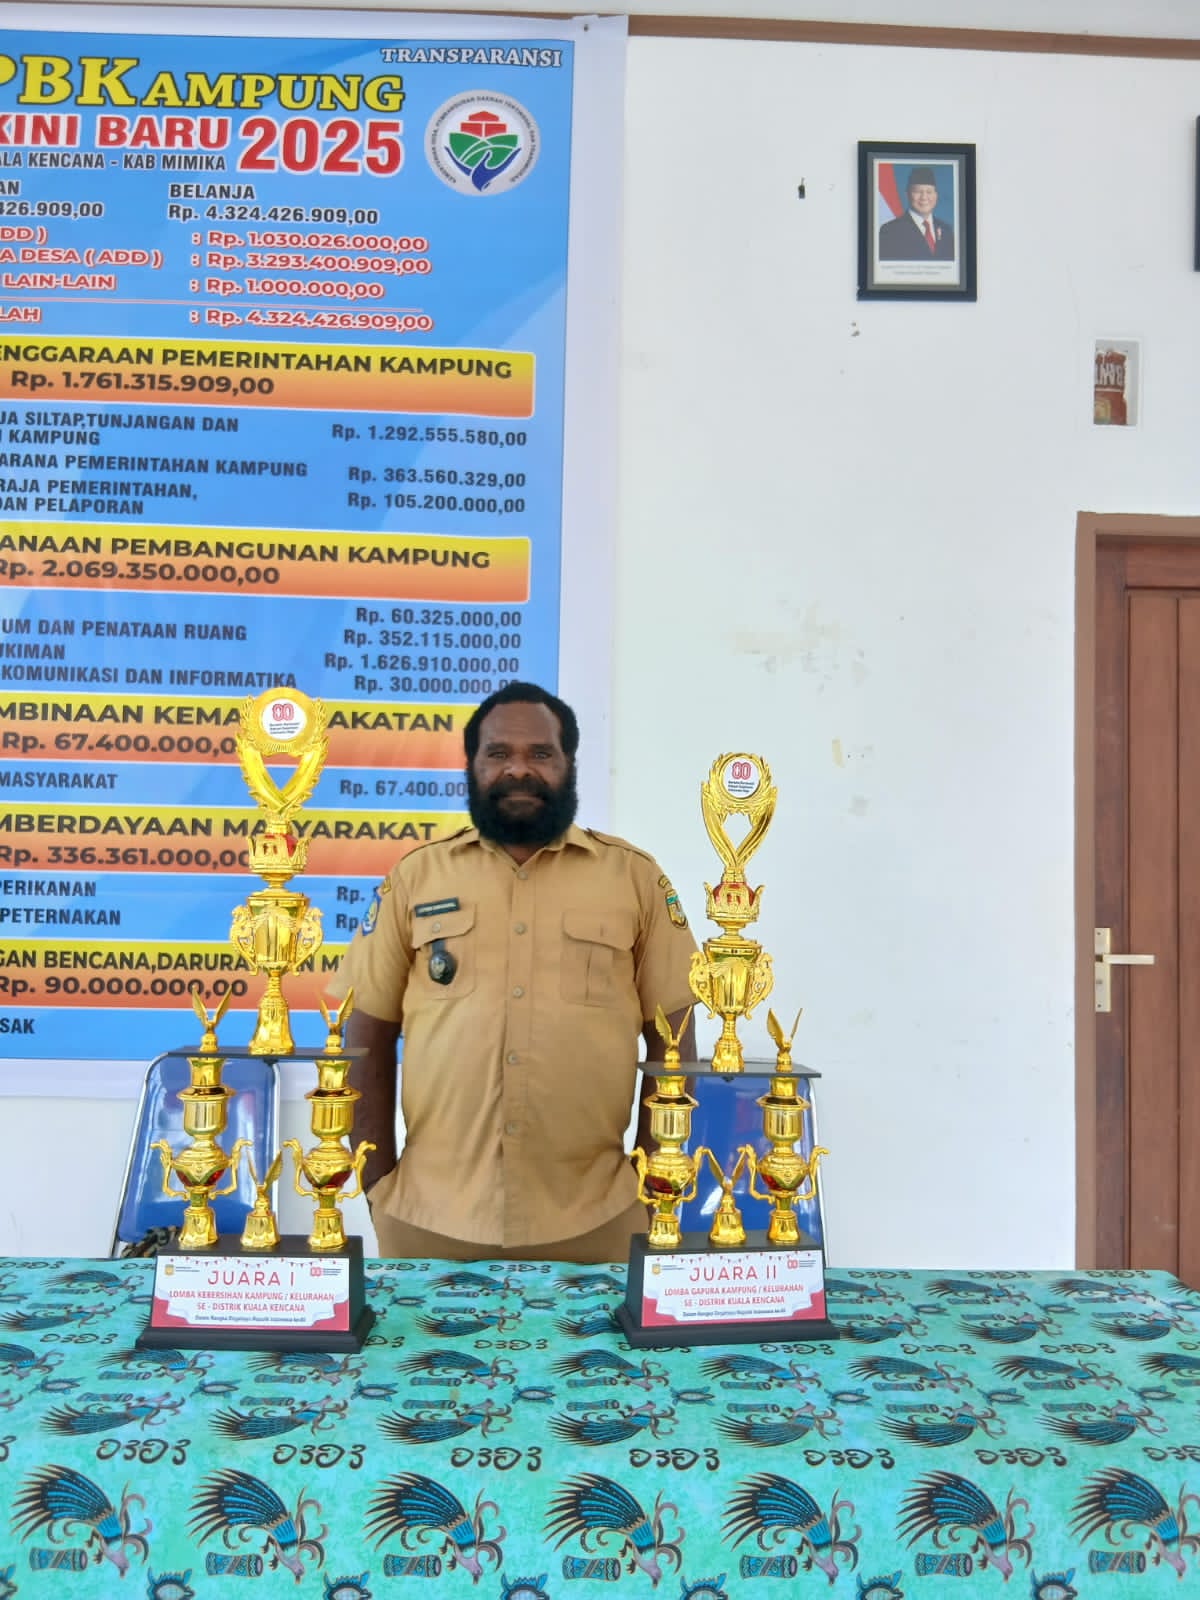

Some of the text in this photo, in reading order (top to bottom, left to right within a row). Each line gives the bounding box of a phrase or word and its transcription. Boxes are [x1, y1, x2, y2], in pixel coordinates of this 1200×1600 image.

[381, 48, 562, 68] TRANSPARANSI
[97, 115, 230, 149] BARU
[239, 117, 403, 174] 2025
[0, 152, 22, 168] LA
[28, 152, 104, 169] KENCANA
[123, 154, 155, 170] KAB
[161, 155, 226, 170] MIMIKA
[169, 183, 254, 200] BELANJA
[168, 204, 379, 226] Rp. 4.324.426.909,00
[208, 231, 245, 250] Rp.
[248, 232, 429, 253] 1.030.026.000,00
[21, 249, 81, 266] DESA
[207, 252, 245, 272] Rp.
[247, 253, 433, 276] 3.293.400.909,00
[4, 273, 117, 291] LAIN-LAIN
[206, 278, 243, 297] Rp.
[246, 279, 385, 301] 1.000.000,00
[206, 309, 243, 328] Rp.
[246, 311, 434, 333] 4.324.426.909,00
[0, 345, 512, 379] NGGARAAN PEMERINTAHAN KAMPUNG
[11, 370, 275, 397] Rp. 1.761.315.909,00
[25, 411, 196, 432] SILTAP,TUNJANGAN
[202, 416, 239, 432] DAN
[9, 429, 101, 446] KAMPUNG
[331, 424, 527, 448] Rp. 1.292.555.580,00
[65, 455, 209, 473] PEMERINTAHAN
[215, 460, 308, 477] KAMPUNG
[348, 466, 526, 490] Rp. 363.560.329,00
[47, 479, 198, 501] PEMERINTAHAN,
[34, 497, 144, 514] PELAPORAN
[347, 492, 526, 515] Rp. 105.200.000,00
[111, 537, 338, 562] PEMBANGUNAN
[348, 546, 490, 568] KAMPUNG
[42, 559, 280, 586] 2.069.350.000,00
[356, 607, 522, 628] Rp. 60.325.000,00
[2, 619, 247, 641] UM DAN PENATAAN RUANG
[344, 629, 521, 652] Rp. 352.115.000,00
[324, 653, 519, 676] Rp. 1.626.910.000,00
[2, 664, 297, 689] KOMUNIKASI DAN INFORMATIKA
[354, 675, 383, 694] Rp.
[3, 731, 46, 753] Rp.
[0, 771, 118, 789] MASYARAKAT
[340, 779, 369, 797] Rp.
[337, 885, 365, 904] Rp.
[0, 907, 121, 926] PETERNAKAN
[44, 976, 248, 999] 90.000.000,00
[207, 1270, 281, 1287] JUARA
[290, 1271, 295, 1286] I
[690, 1265, 758, 1282] JUARA
[766, 1264, 777, 1280] II
[169, 1290, 195, 1299] LOMBA
[245, 1291, 283, 1301] KAMPUNG
[290, 1292, 335, 1302] KELURAHAN
[664, 1287, 689, 1297] LOMBA
[721, 1285, 757, 1295] KAMPUNG
